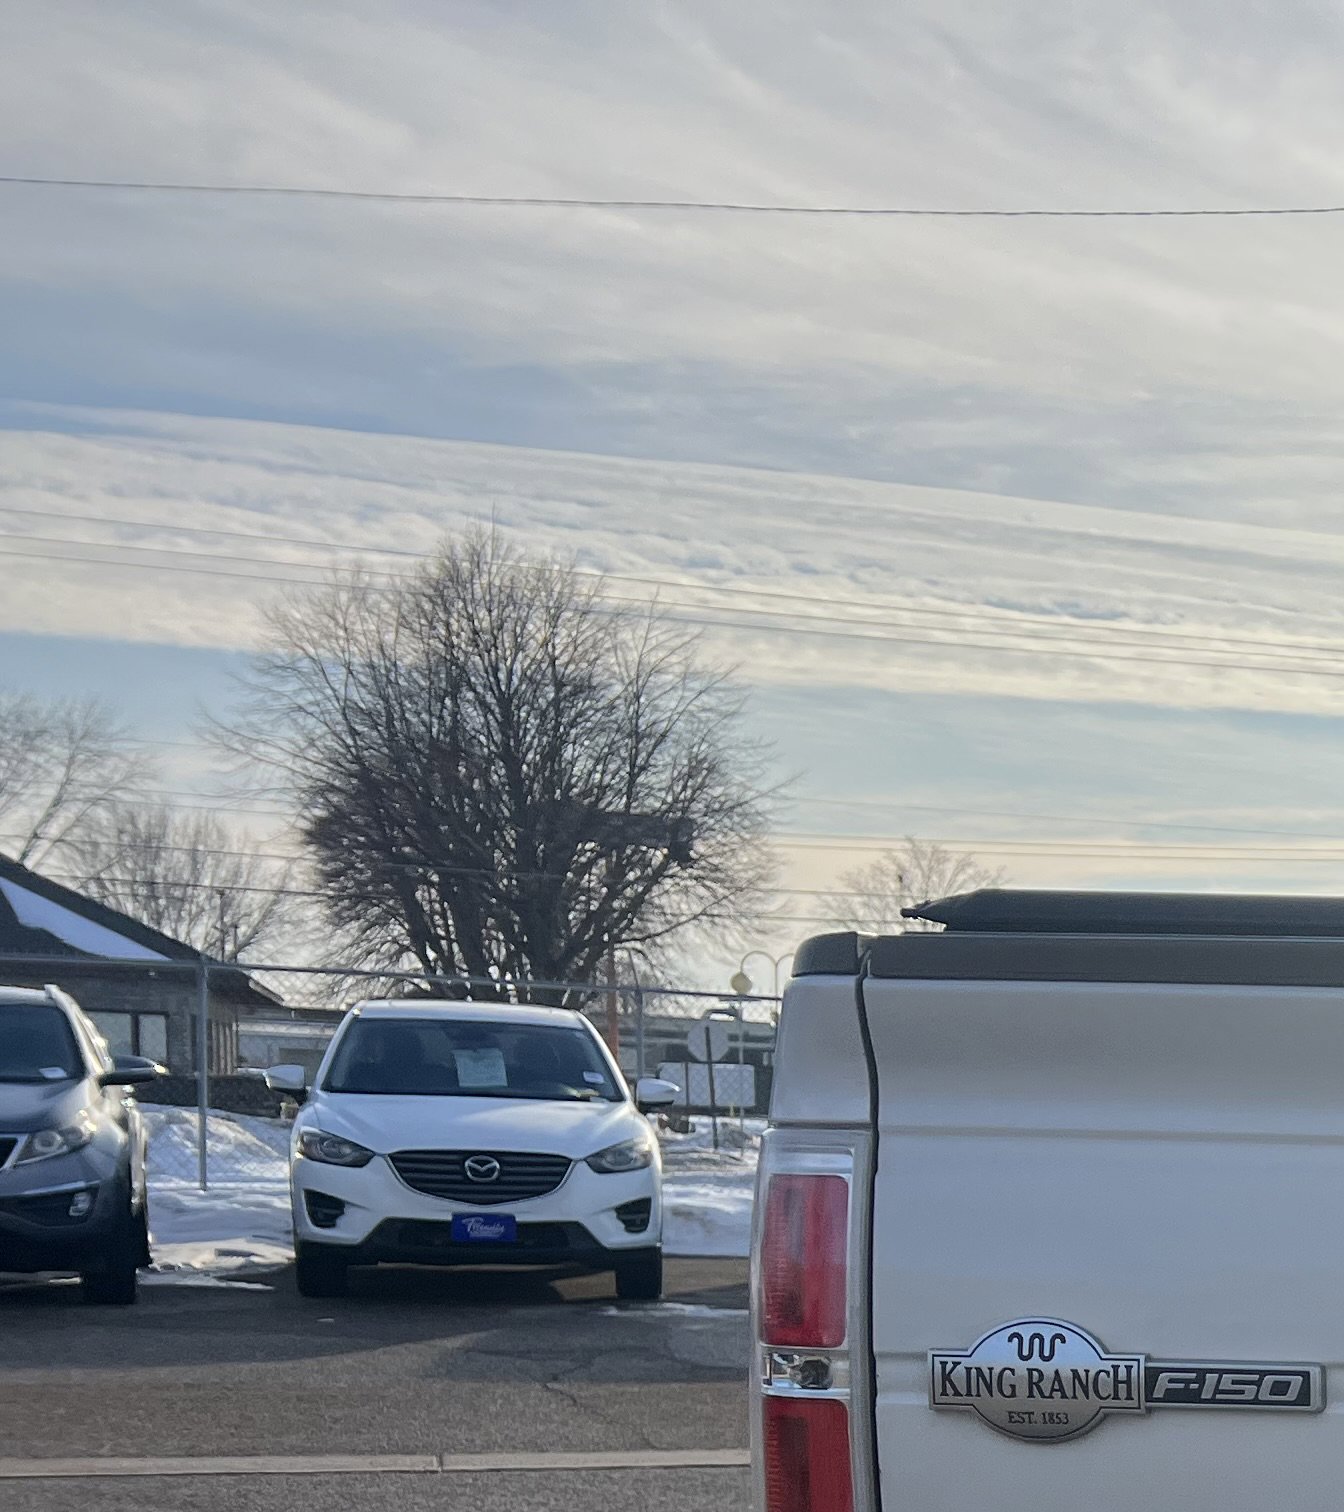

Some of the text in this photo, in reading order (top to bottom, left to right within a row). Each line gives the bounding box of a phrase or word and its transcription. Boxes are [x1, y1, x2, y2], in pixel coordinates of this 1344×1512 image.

[939, 1361, 1135, 1400] KING RANCH
[1152, 1372, 1304, 1401] F-150
[1008, 1411, 1069, 1425] EST. 1853
